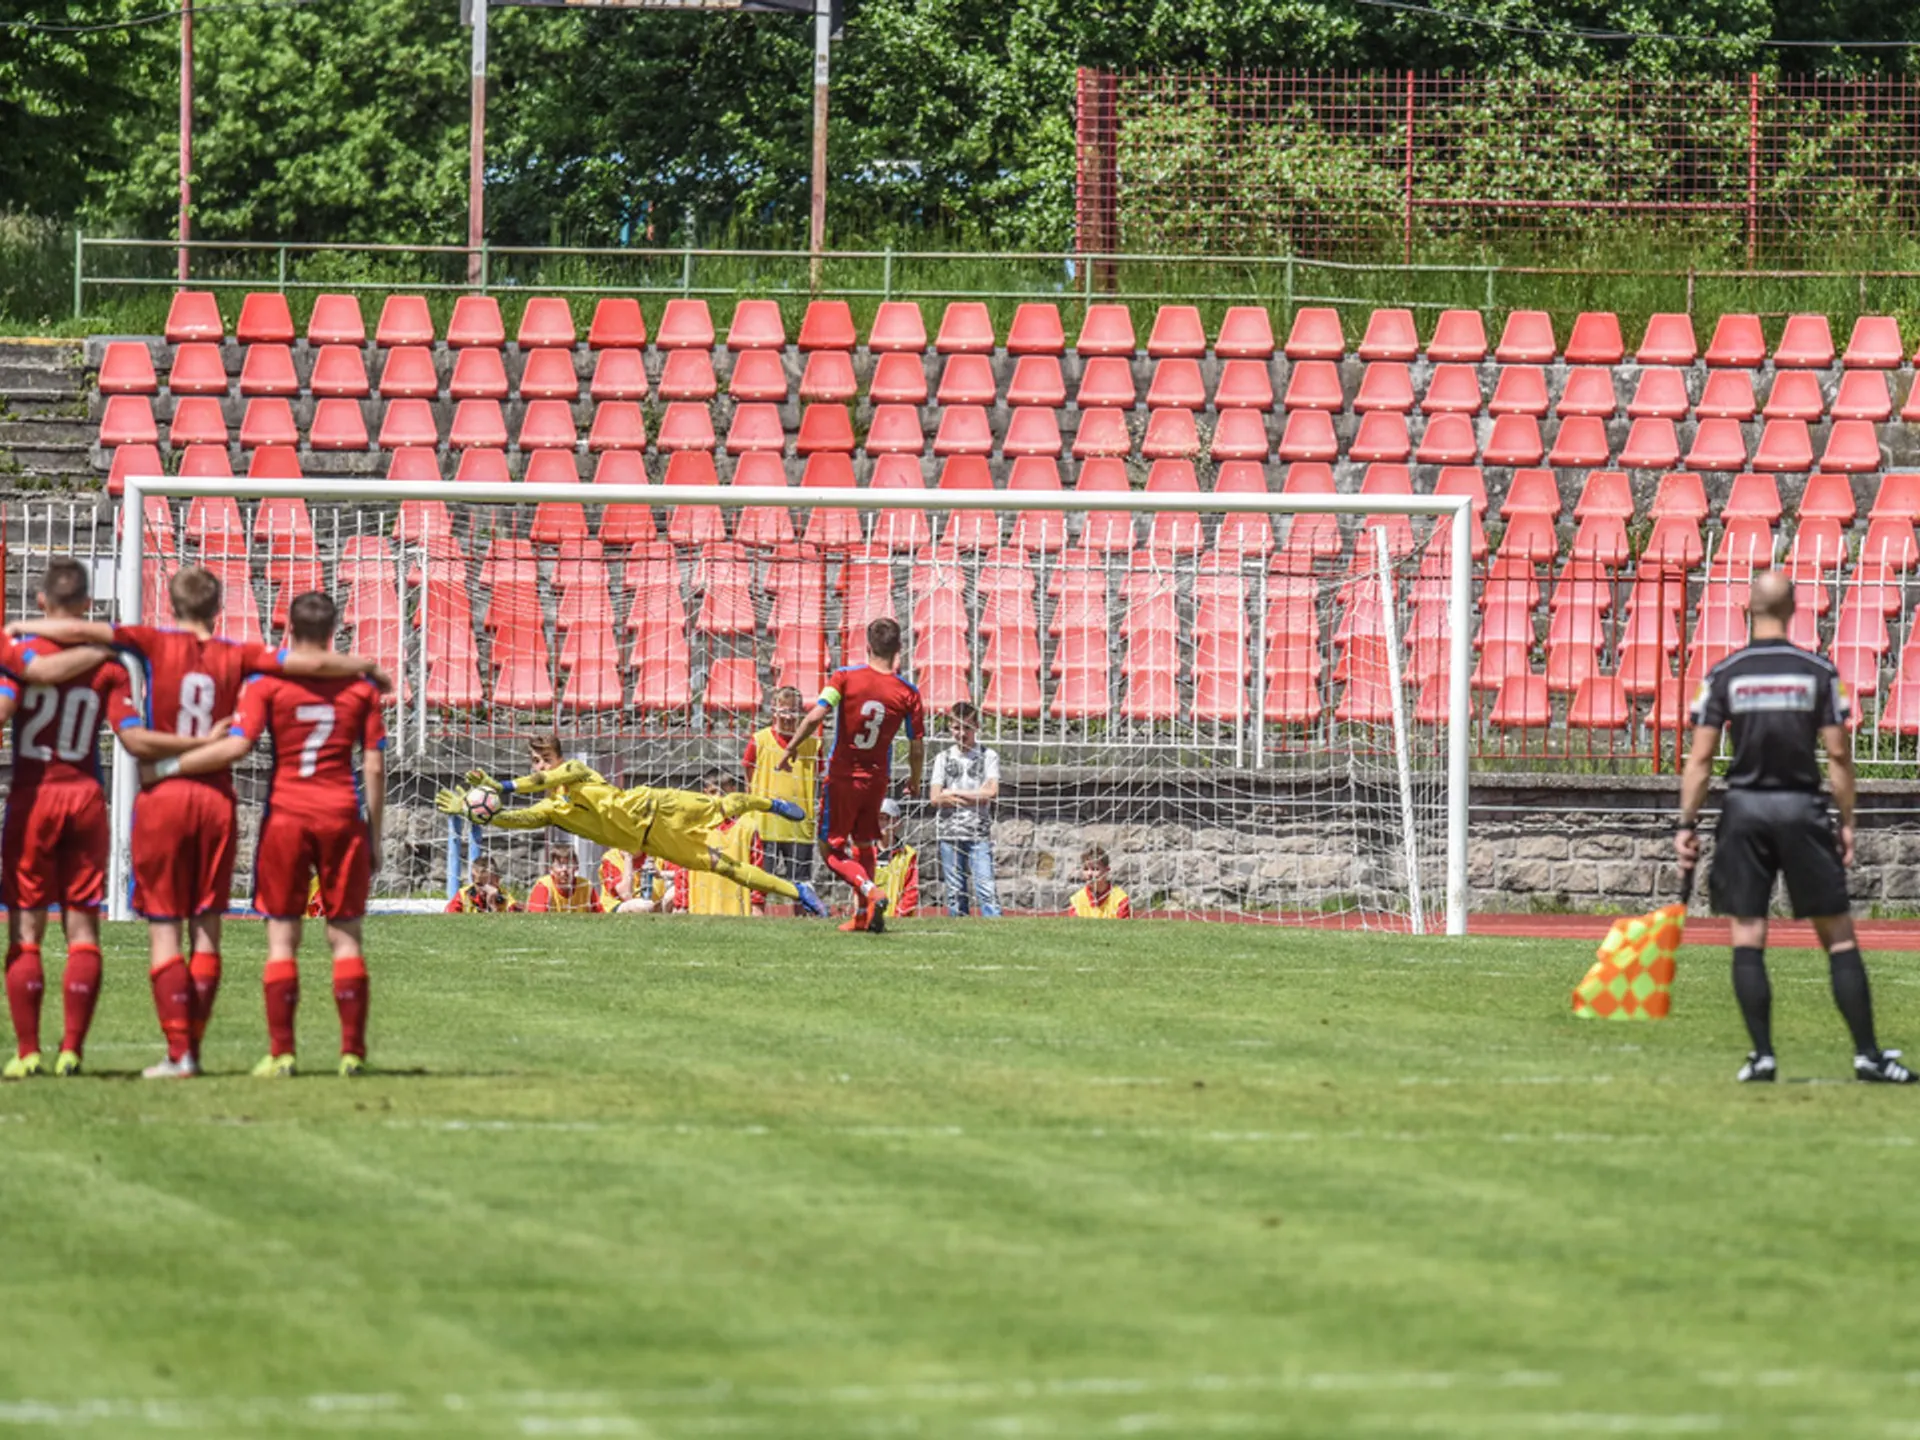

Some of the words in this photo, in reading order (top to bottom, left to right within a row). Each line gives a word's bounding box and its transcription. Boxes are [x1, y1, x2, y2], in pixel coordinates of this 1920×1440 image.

[19, 686, 100, 761] 20
[176, 672, 216, 738] 8
[853, 700, 886, 749] 3
[295, 704, 335, 777] 7
